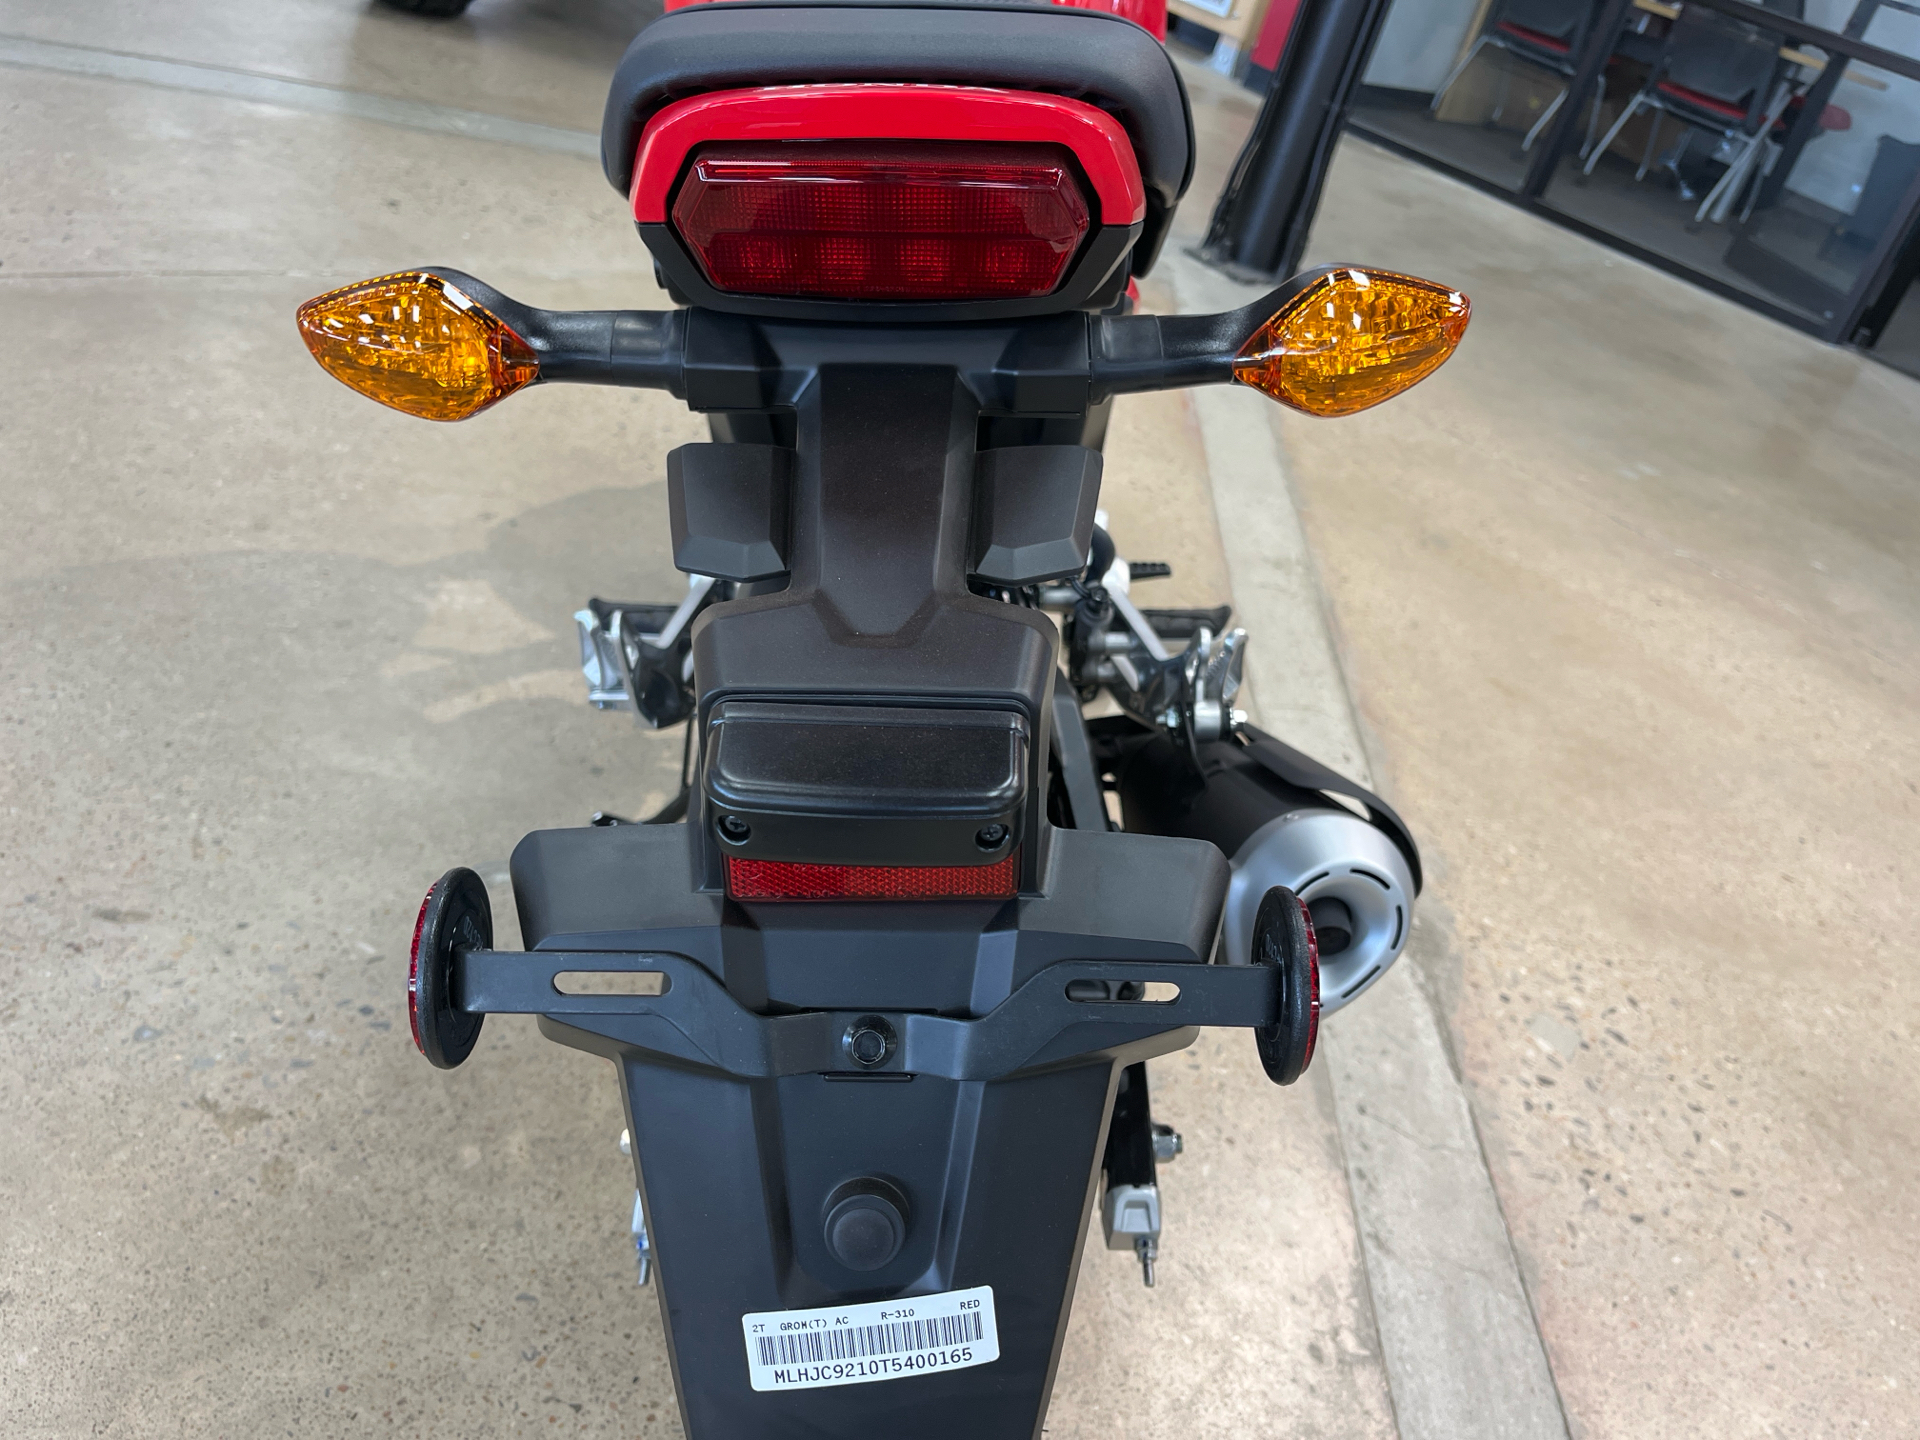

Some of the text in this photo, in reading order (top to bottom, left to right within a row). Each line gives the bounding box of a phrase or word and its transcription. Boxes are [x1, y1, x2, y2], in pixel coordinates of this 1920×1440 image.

[752, 1324, 766, 1333] 2T
[835, 1316, 849, 1326] AC
[881, 1308, 915, 1320] R-310
[960, 1299, 980, 1310] RED
[773, 1346, 973, 1384] MLHJC9210T5400165
